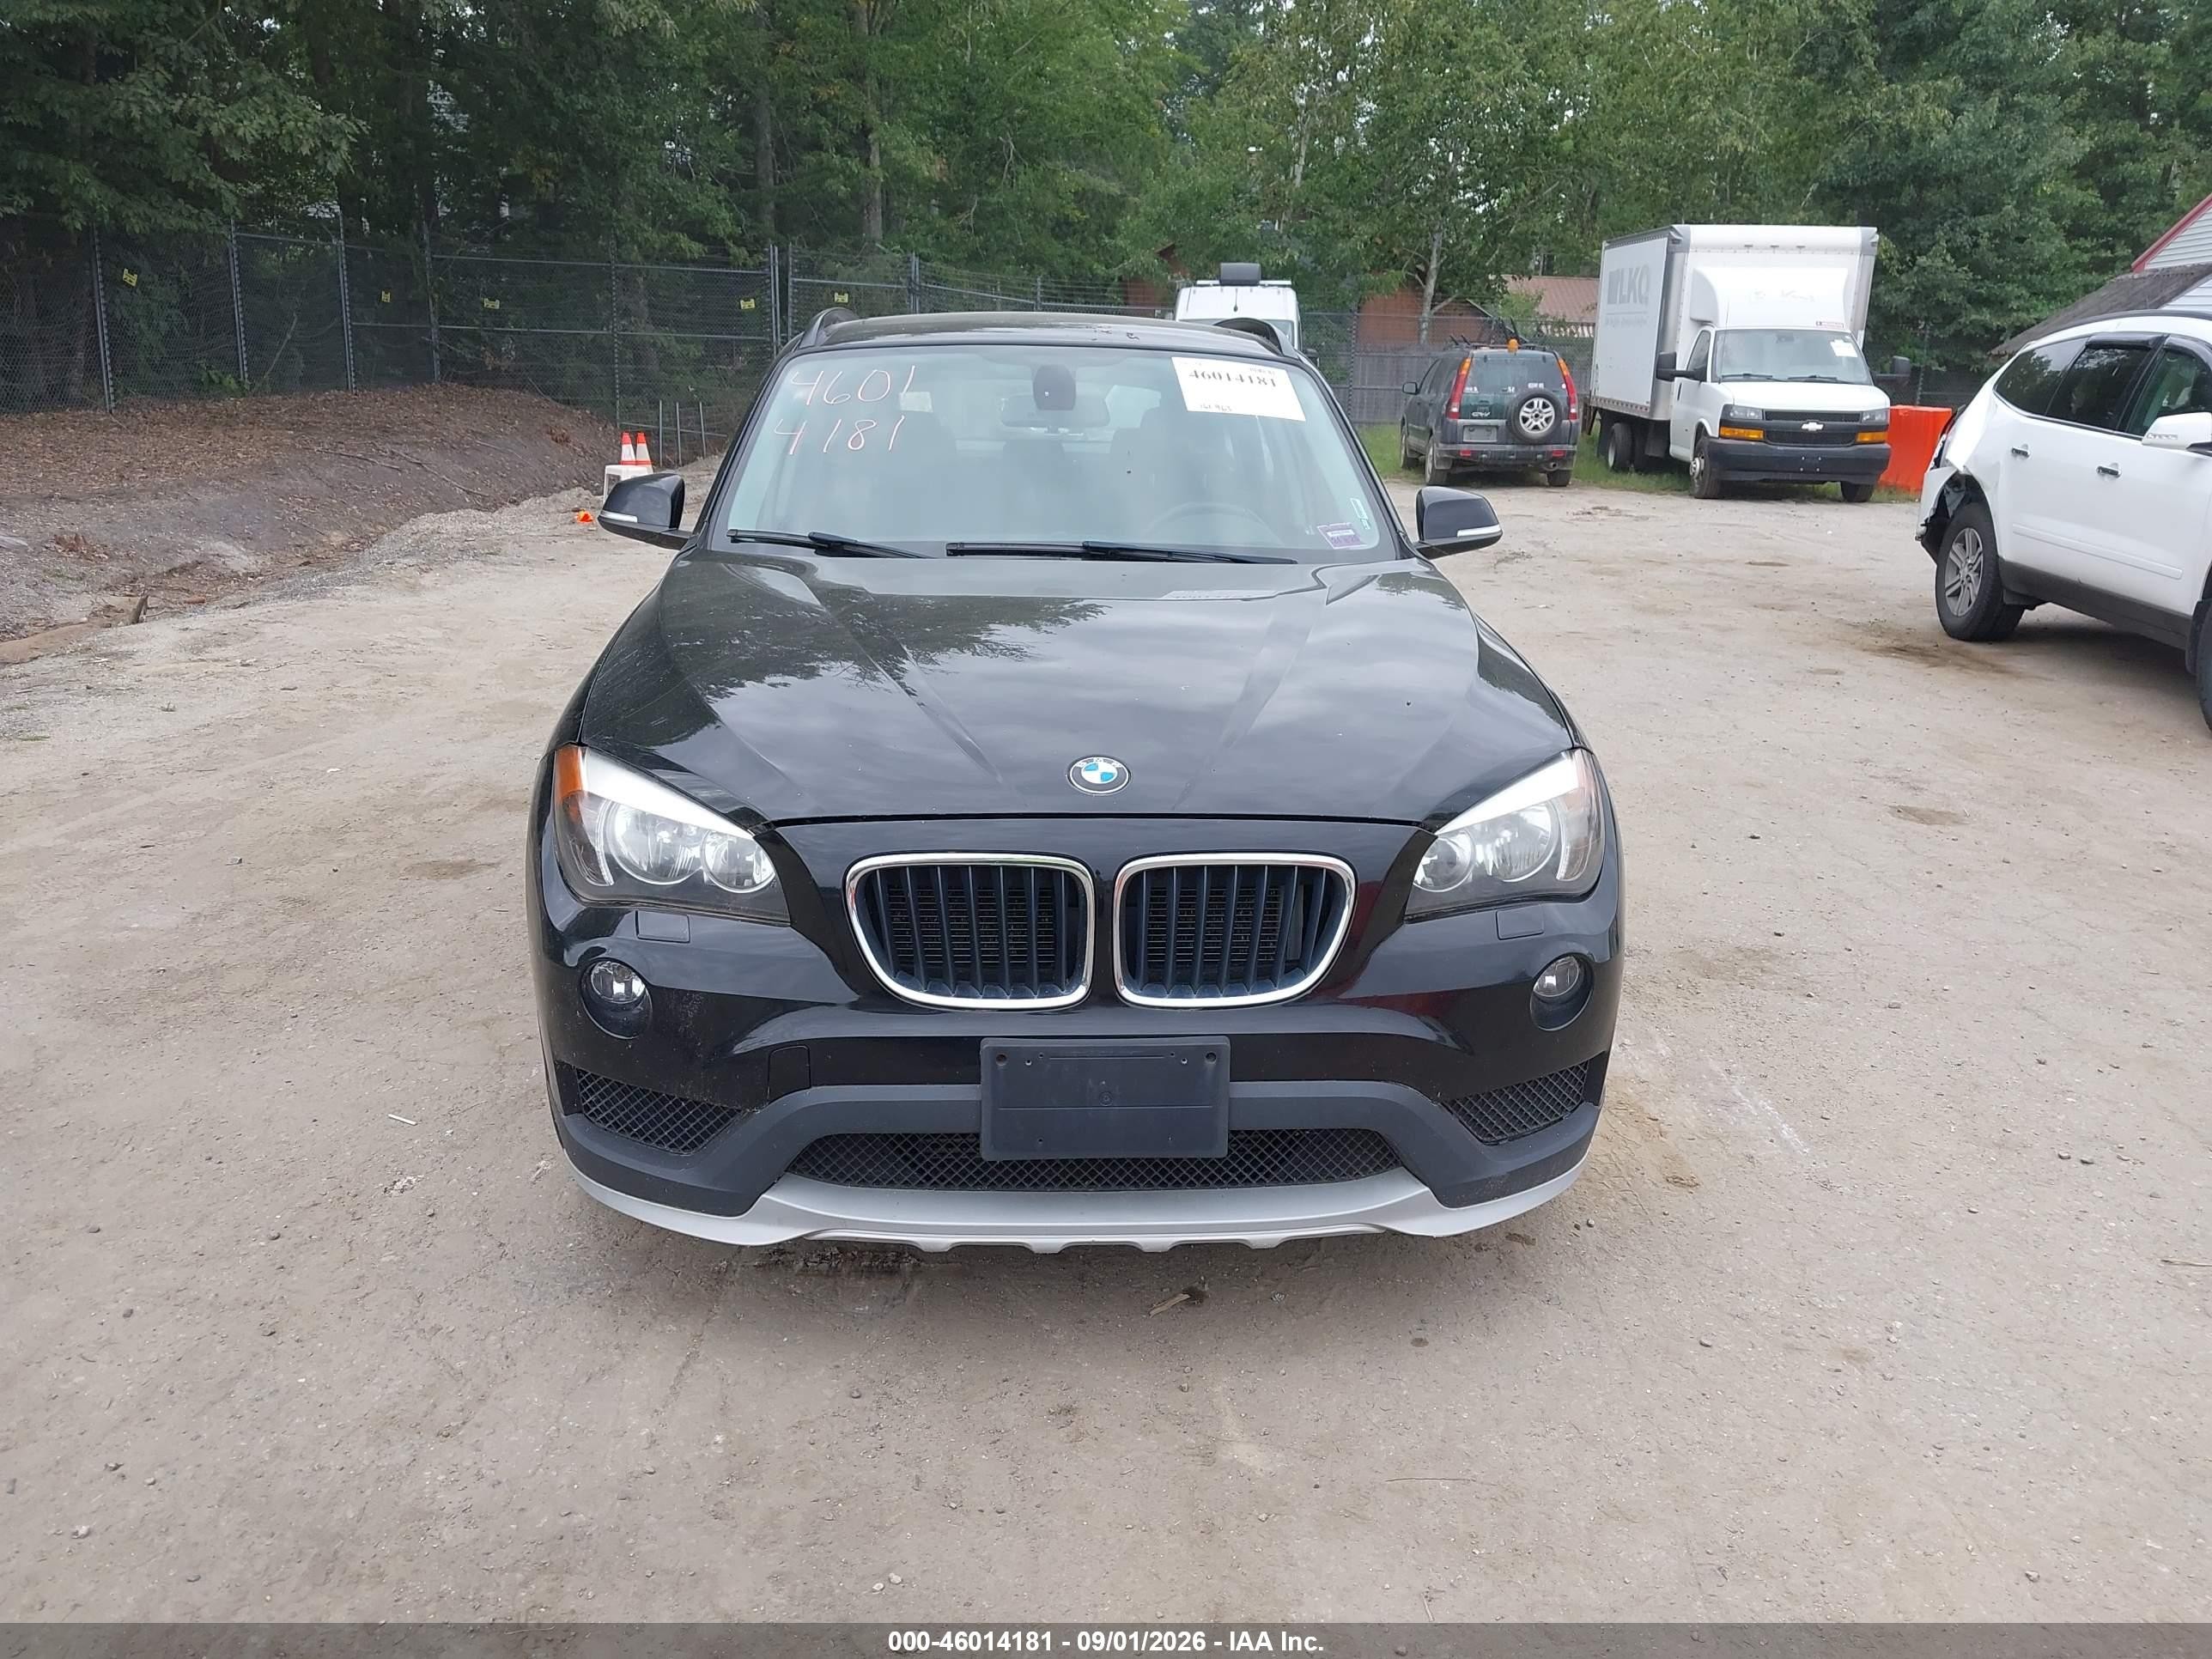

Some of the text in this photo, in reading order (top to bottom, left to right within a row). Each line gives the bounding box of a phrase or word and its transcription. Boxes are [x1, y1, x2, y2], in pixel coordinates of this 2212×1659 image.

[790, 365, 916, 406] 4601
[1188, 369, 1277, 387] 46014181
[774, 415, 906, 455] 4181
